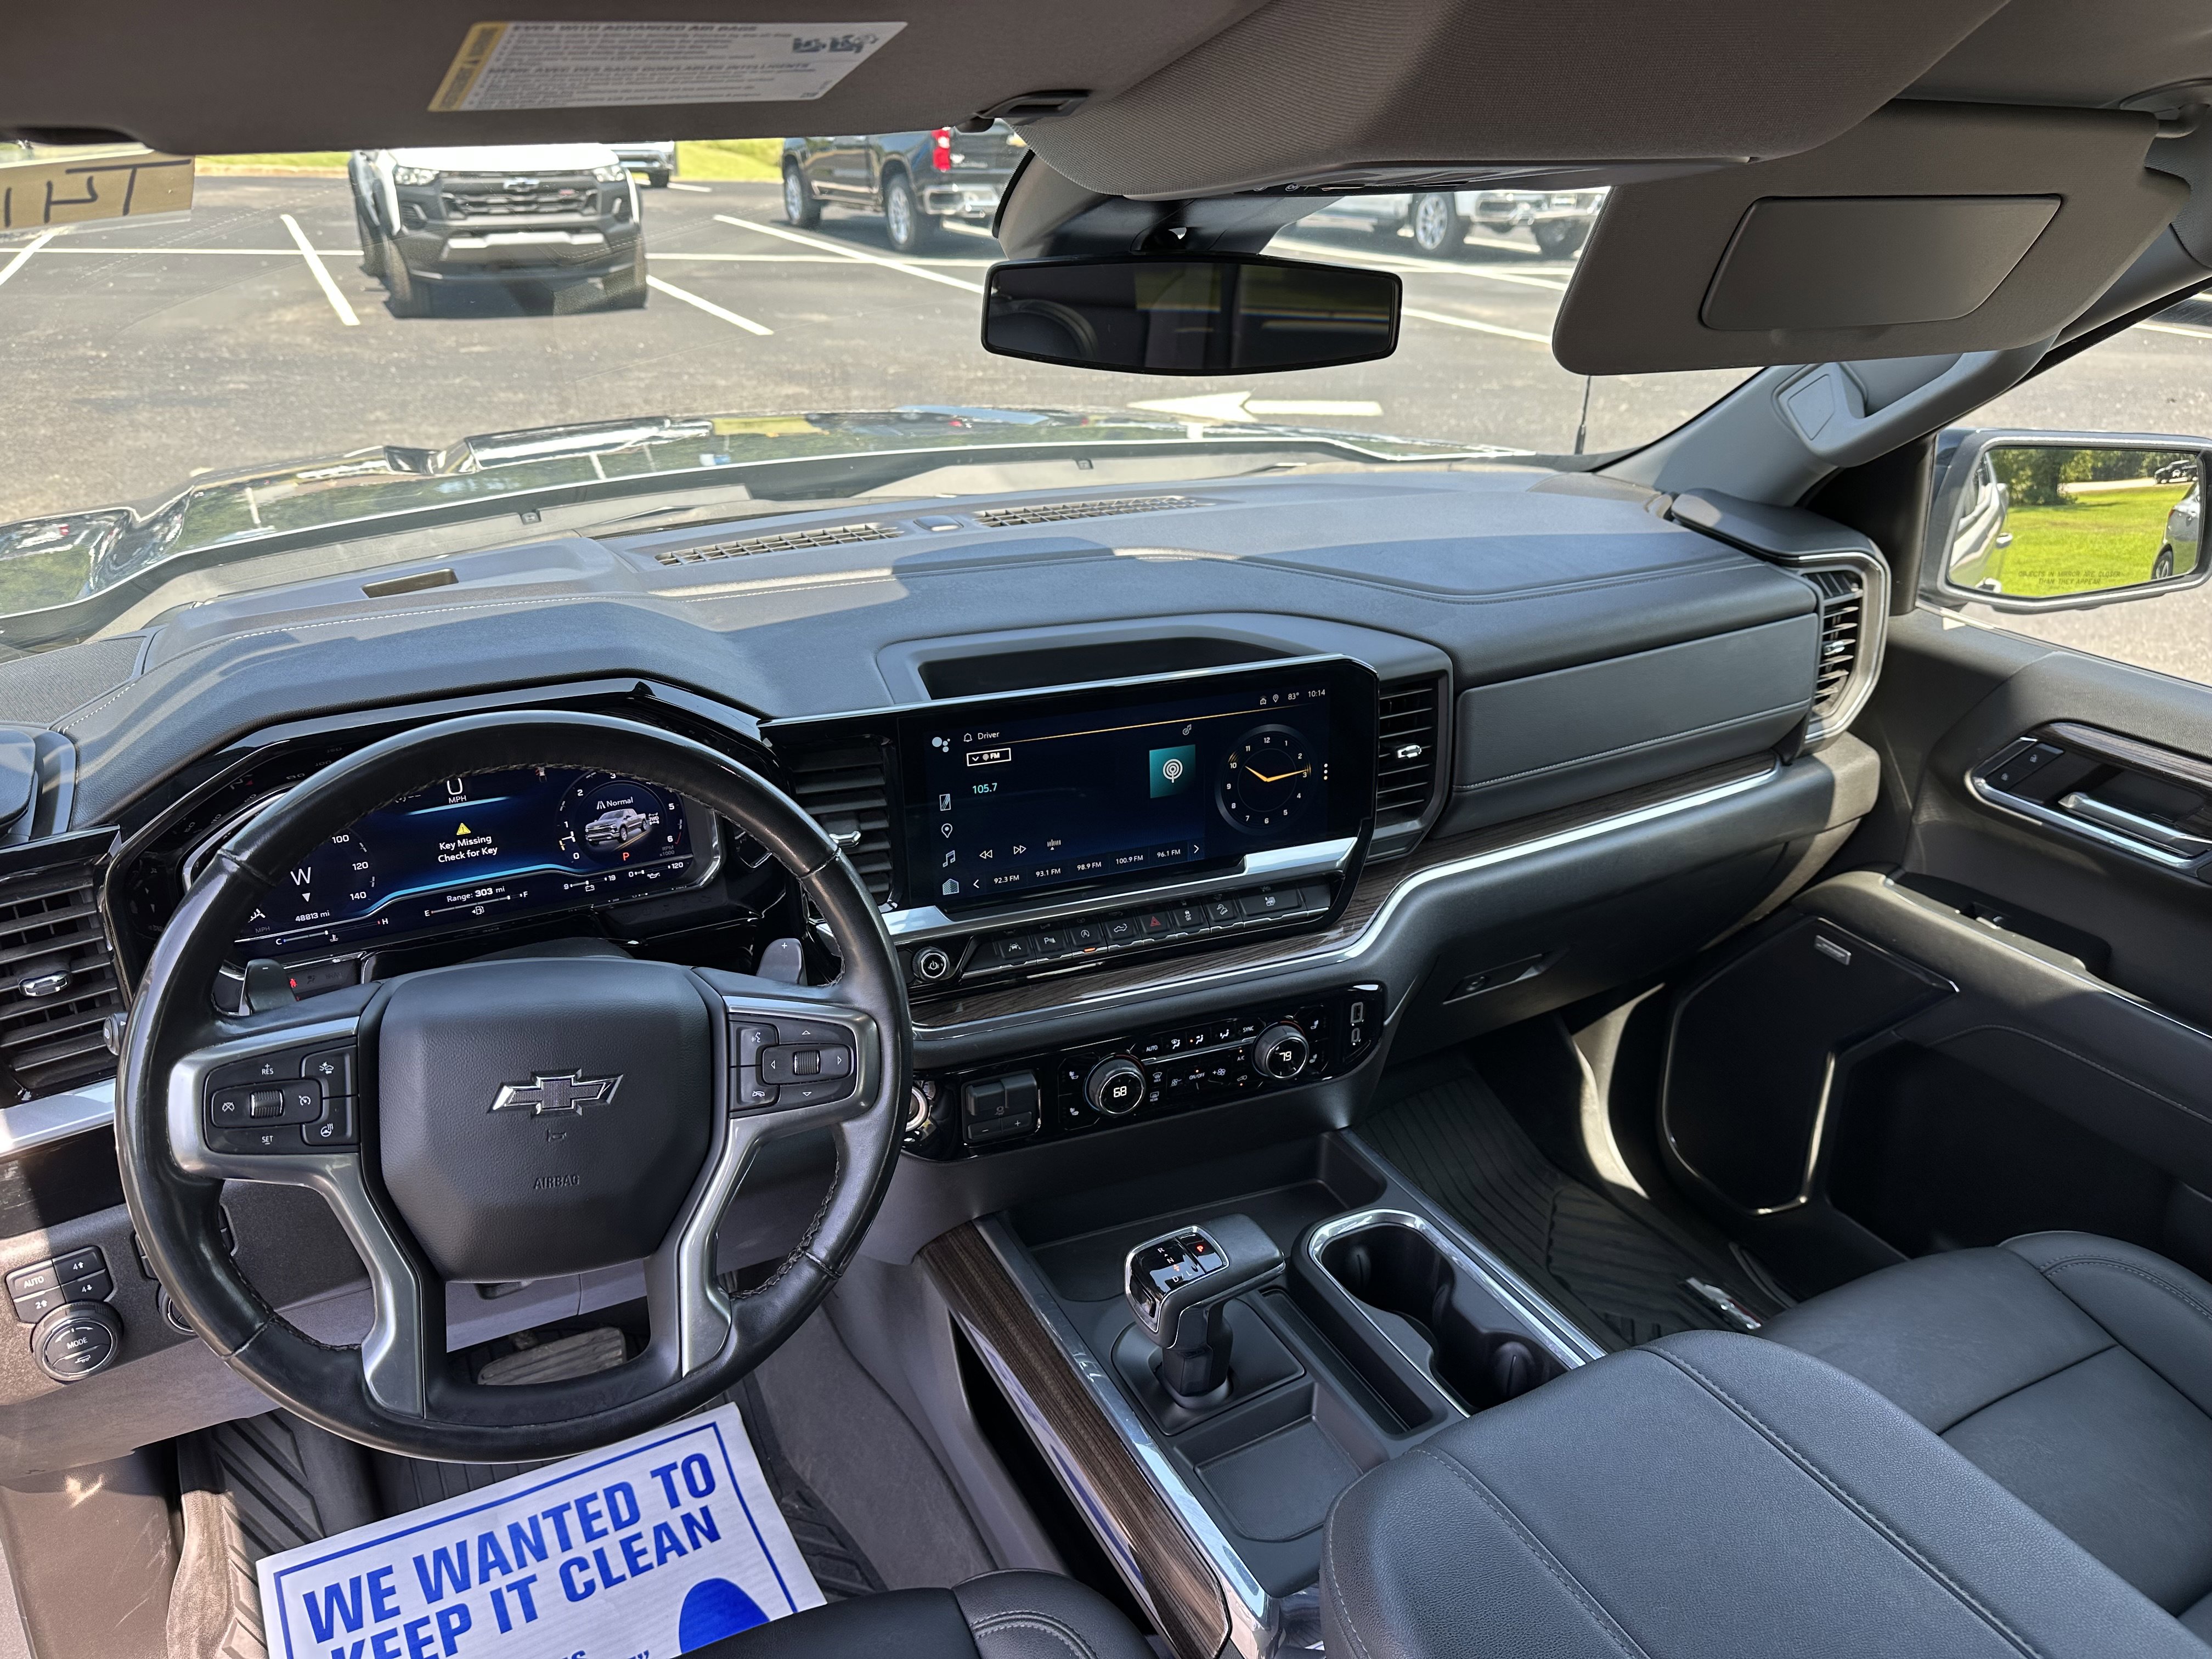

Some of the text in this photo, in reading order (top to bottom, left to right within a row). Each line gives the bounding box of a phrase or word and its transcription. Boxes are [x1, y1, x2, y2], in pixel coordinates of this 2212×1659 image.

[1308, 689, 1325, 698] 10:14
[978, 731, 1000, 740] Driver
[972, 783, 998, 794] 105.7
[448, 795, 467, 804] MPH
[606, 797, 634, 808] Normal
[331, 834, 349, 844] 100
[439, 835, 492, 852] Key Missing
[438, 846, 498, 863] Check for Key
[623, 852, 630, 861] P
[671, 861, 684, 870] 120
[1115, 856, 1132, 865] 100.9
[352, 861, 369, 871] 120
[1077, 863, 1091, 871] 98.9
[290, 867, 311, 885] W
[1036, 870, 1049, 878] 93.1
[994, 876, 1008, 884] 92.3
[350, 891, 366, 900] 140
[447, 885, 505, 904] Range: 303 mi
[295, 910, 330, 922] 48813 mi
[1279, 1051, 1292, 1062] 79
[1189, 1072, 1205, 1080] ON/OFF
[1114, 1086, 1127, 1098] 68
[262, 1135, 273, 1143] SET
[534, 1174, 580, 1190] AIRBAG
[24, 1276, 44, 1289] AUTO
[66, 1338, 88, 1350] MODE
[302, 1453, 716, 1644] WE WANTED TO
[490, 1573, 539, 1634] IT
[559, 1505, 721, 1602] CLEAN
